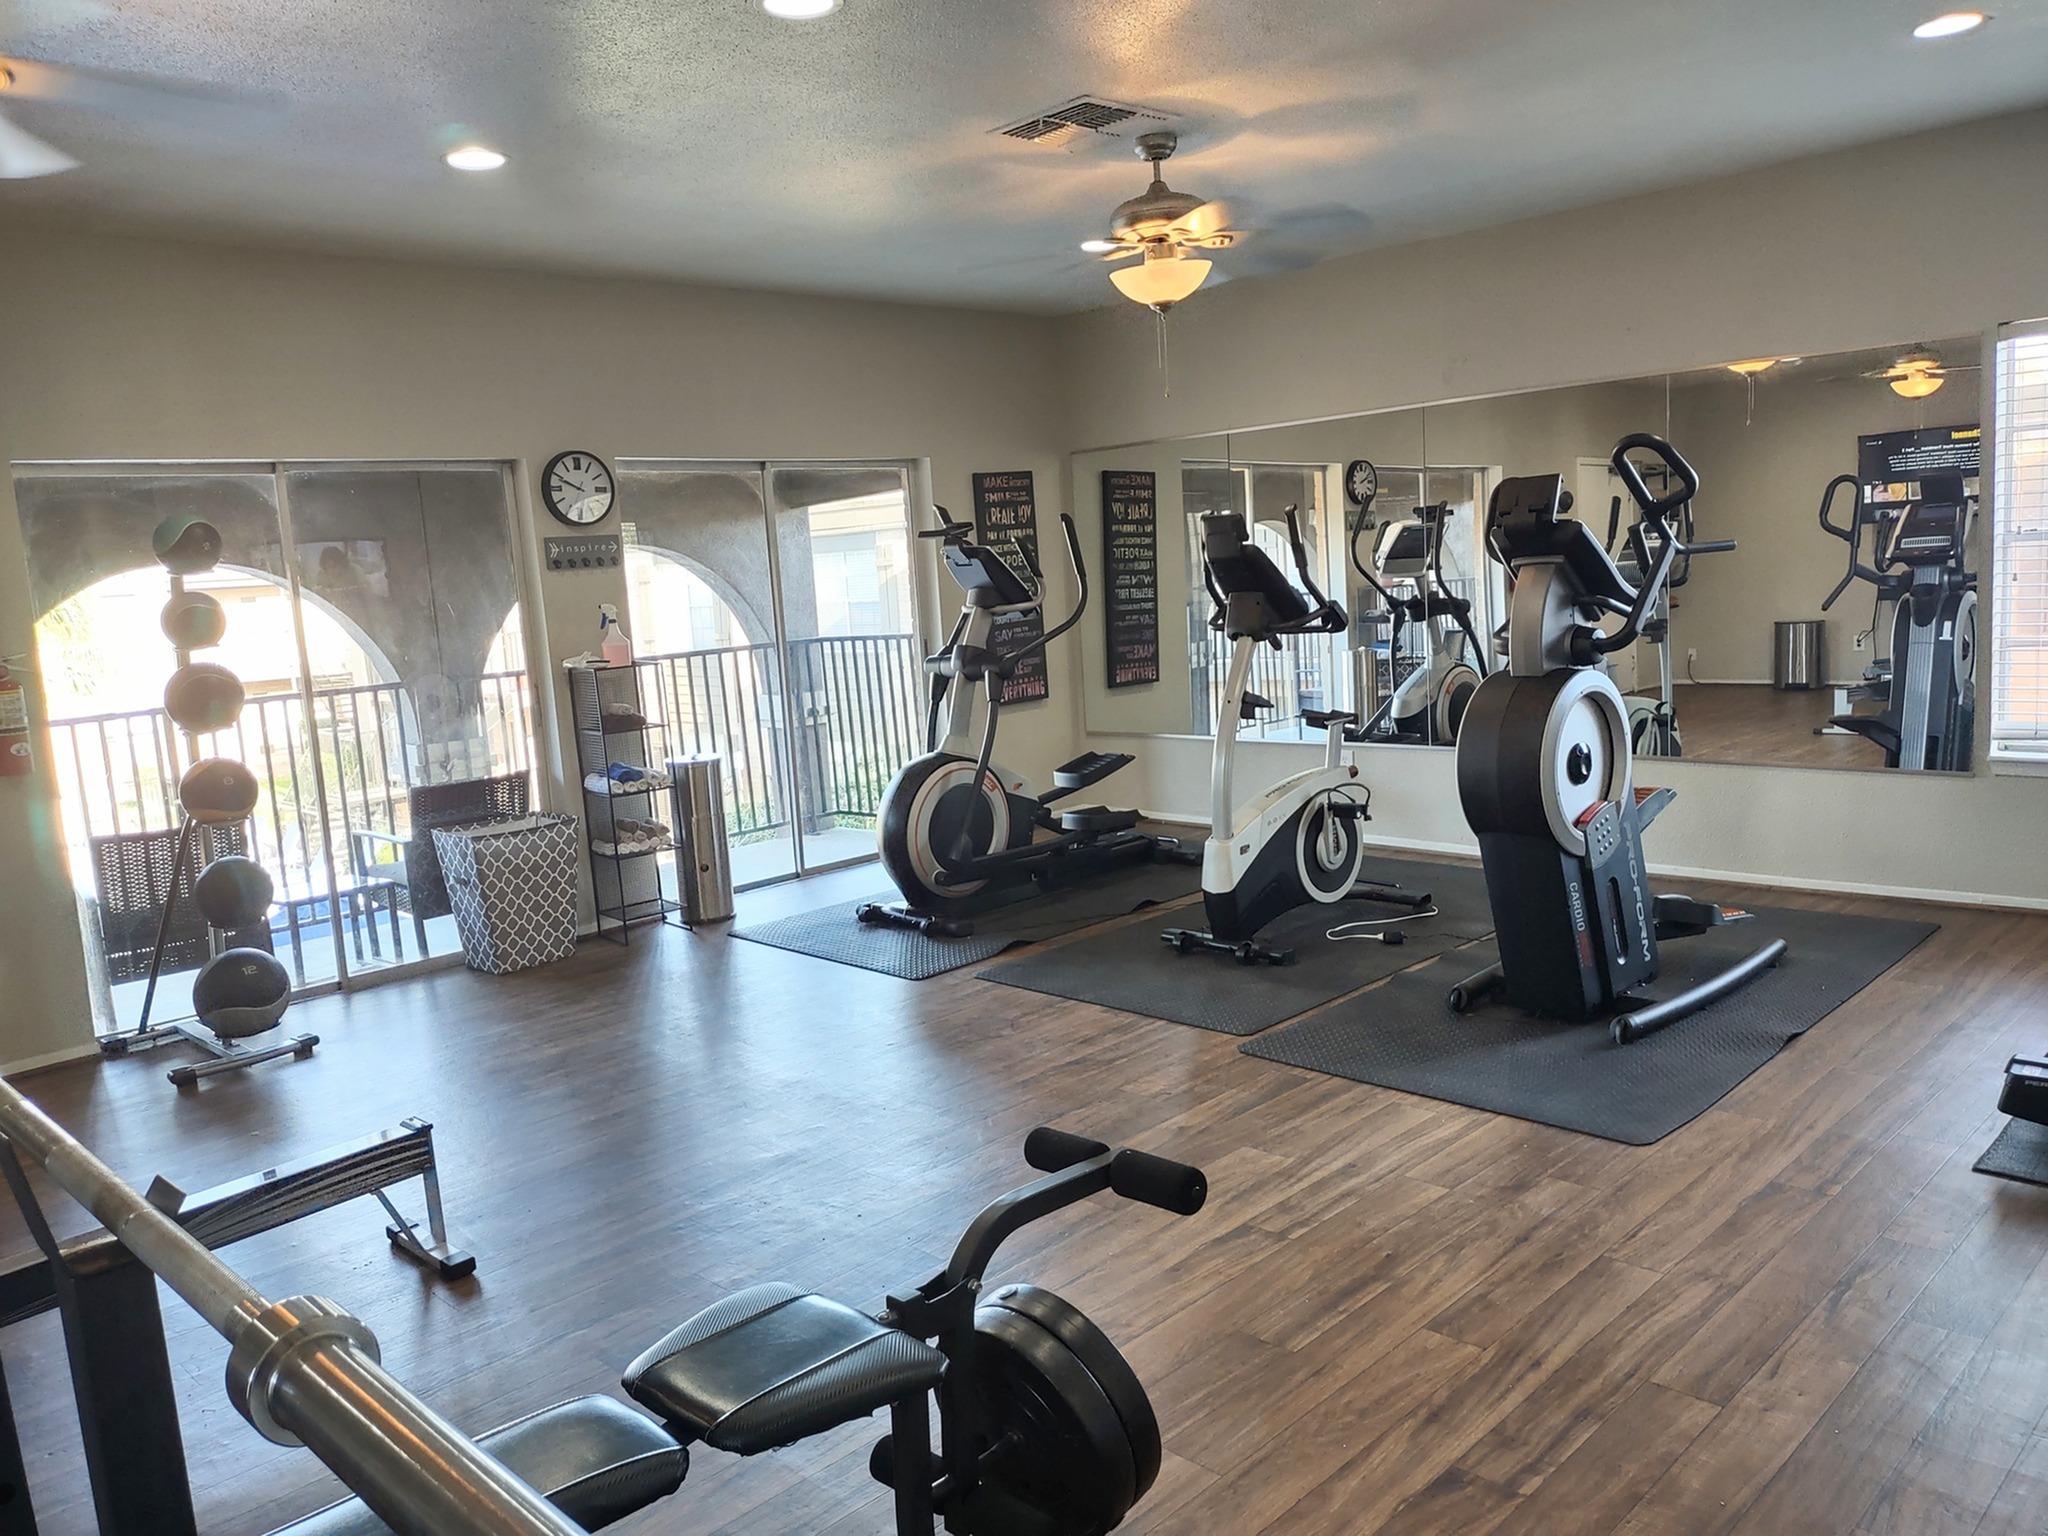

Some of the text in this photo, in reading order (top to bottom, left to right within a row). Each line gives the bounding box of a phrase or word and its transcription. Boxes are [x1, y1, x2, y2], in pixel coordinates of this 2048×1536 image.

[983, 476, 1008, 488] MAKE
[985, 492, 1010, 502] SMILE
[986, 504, 1031, 526] CREATE JOY
[560, 544, 607, 554] inspire
[995, 629, 1013, 642] SAY
[1004, 676, 1043, 686] ELEBRATE
[1001, 680, 1046, 703] VERYTHING
[1569, 882, 1586, 932] CARDIO
[242, 965, 259, 976] 12
